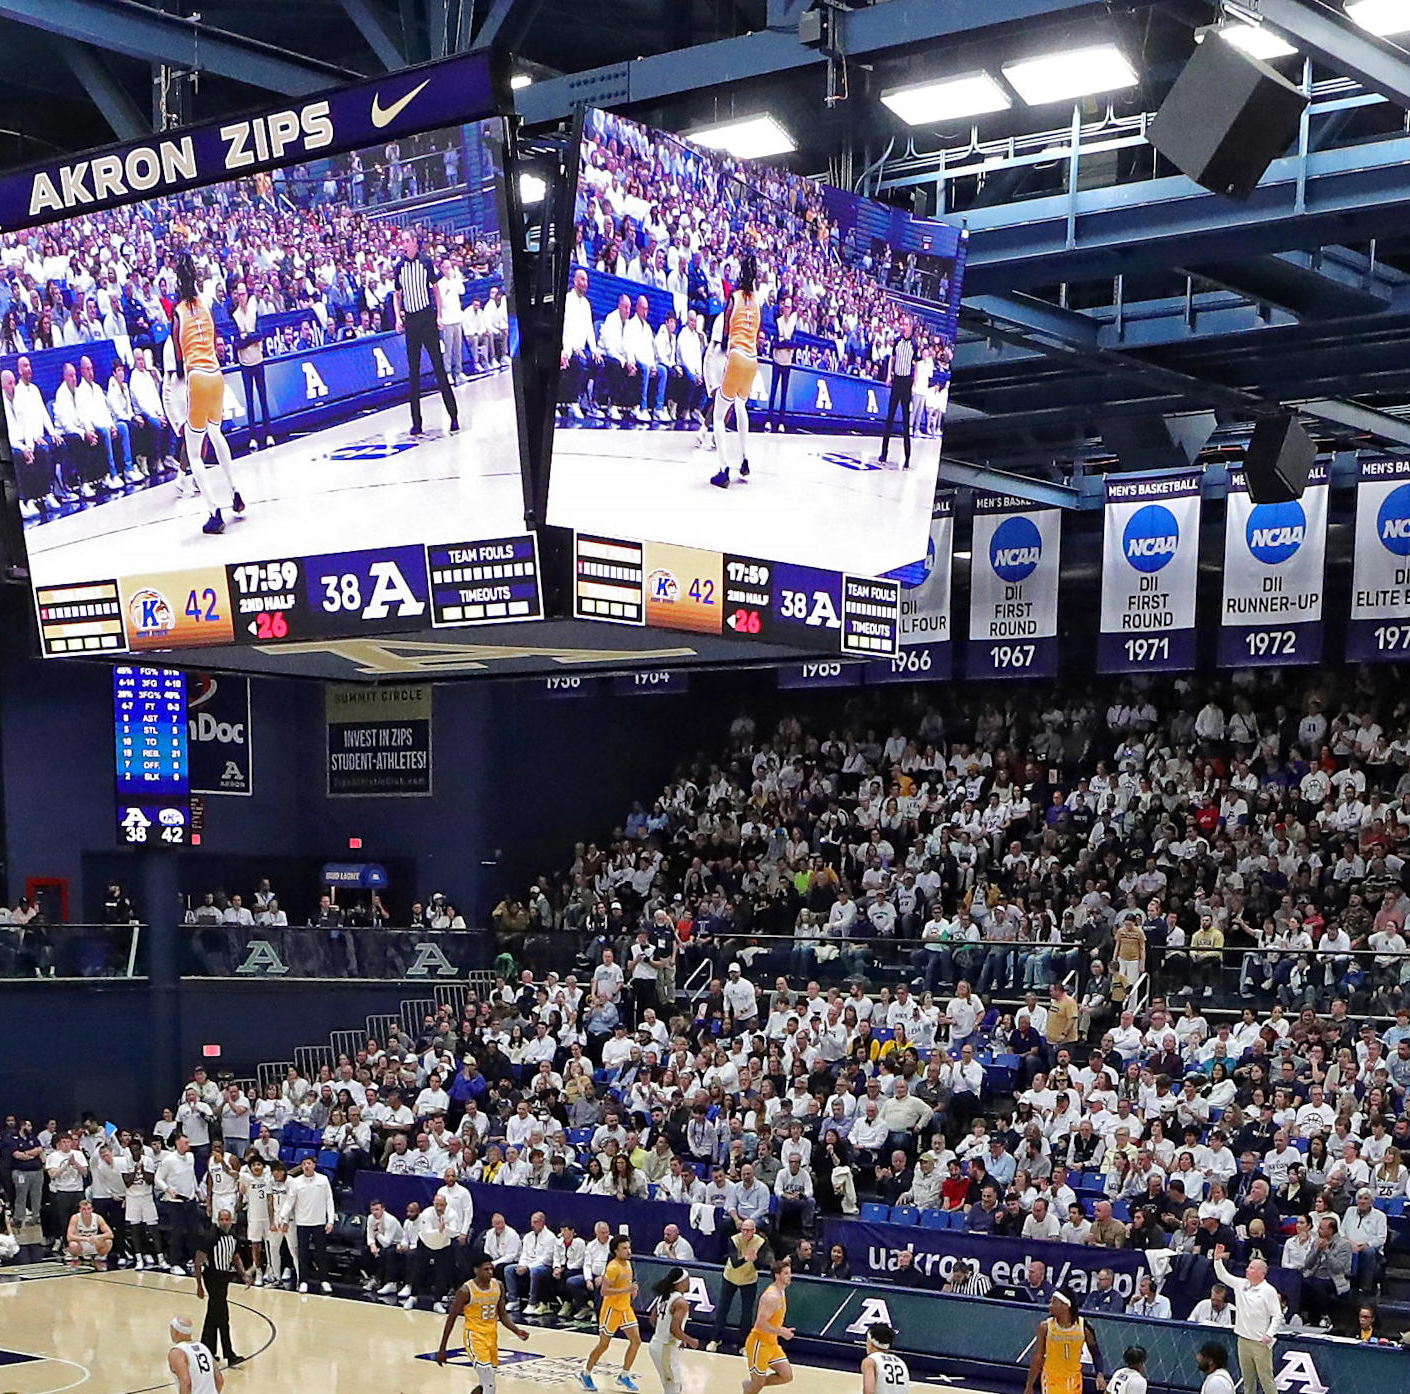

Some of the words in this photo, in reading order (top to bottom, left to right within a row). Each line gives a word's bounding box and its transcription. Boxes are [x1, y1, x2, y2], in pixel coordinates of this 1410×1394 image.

[28, 136, 198, 216] AKRON
[220, 101, 335, 170] ZIPS
[1362, 462, 1394, 475] MEN'S
[1108, 484, 1137, 497] MEN'S
[1138, 479, 1198, 495] BASKETBALL
[976, 497, 1002, 509] MEN'S
[1128, 535, 1177, 557] NCAA
[1251, 526, 1303, 548] NCAA
[448, 548, 477, 564] TEAM
[478, 545, 514, 561] FOULS
[994, 546, 1039, 567] NCAA
[233, 562, 298, 594] 17:59
[727, 561, 769, 586] 17:59
[322, 576, 361, 611] 38
[361, 561, 425, 620] A
[459, 585, 511, 602] TIMEOUTS
[688, 578, 715, 606] 42
[847, 583, 867, 598] TEAM
[870, 586, 896, 602] FOULS
[1357, 589, 1400, 607] ELITE
[184, 589, 220, 623] 42
[780, 591, 807, 619] 38
[805, 591, 841, 629] A
[995, 603, 1033, 618] FIRST
[1128, 594, 1169, 610] FIRST
[1227, 593, 1319, 614] RUNNER-UP
[257, 614, 289, 639] 26
[734, 609, 762, 633] 26
[852, 621, 890, 637] TIMEOUTS
[912, 616, 946, 632] FOUR
[989, 620, 1037, 637] ROUND
[1122, 612, 1173, 630] ROUND
[1125, 637, 1169, 661] 1971
[1246, 631, 1296, 656] 1972
[990, 645, 1035, 668] 1967
[381, 689, 422, 702] CIRCLE
[344, 729, 377, 747] INVEST
[380, 729, 389, 746] IN
[392, 728, 413, 746] ZIPS
[331, 751, 427, 771] STUDENT-ATHLETES!
[126, 827, 147, 842] 38
[161, 827, 183, 842] 42
[1064, 1342, 1069, 1360] 1
[194, 1353, 211, 1373] 13
[883, 1363, 905, 1386] 32
